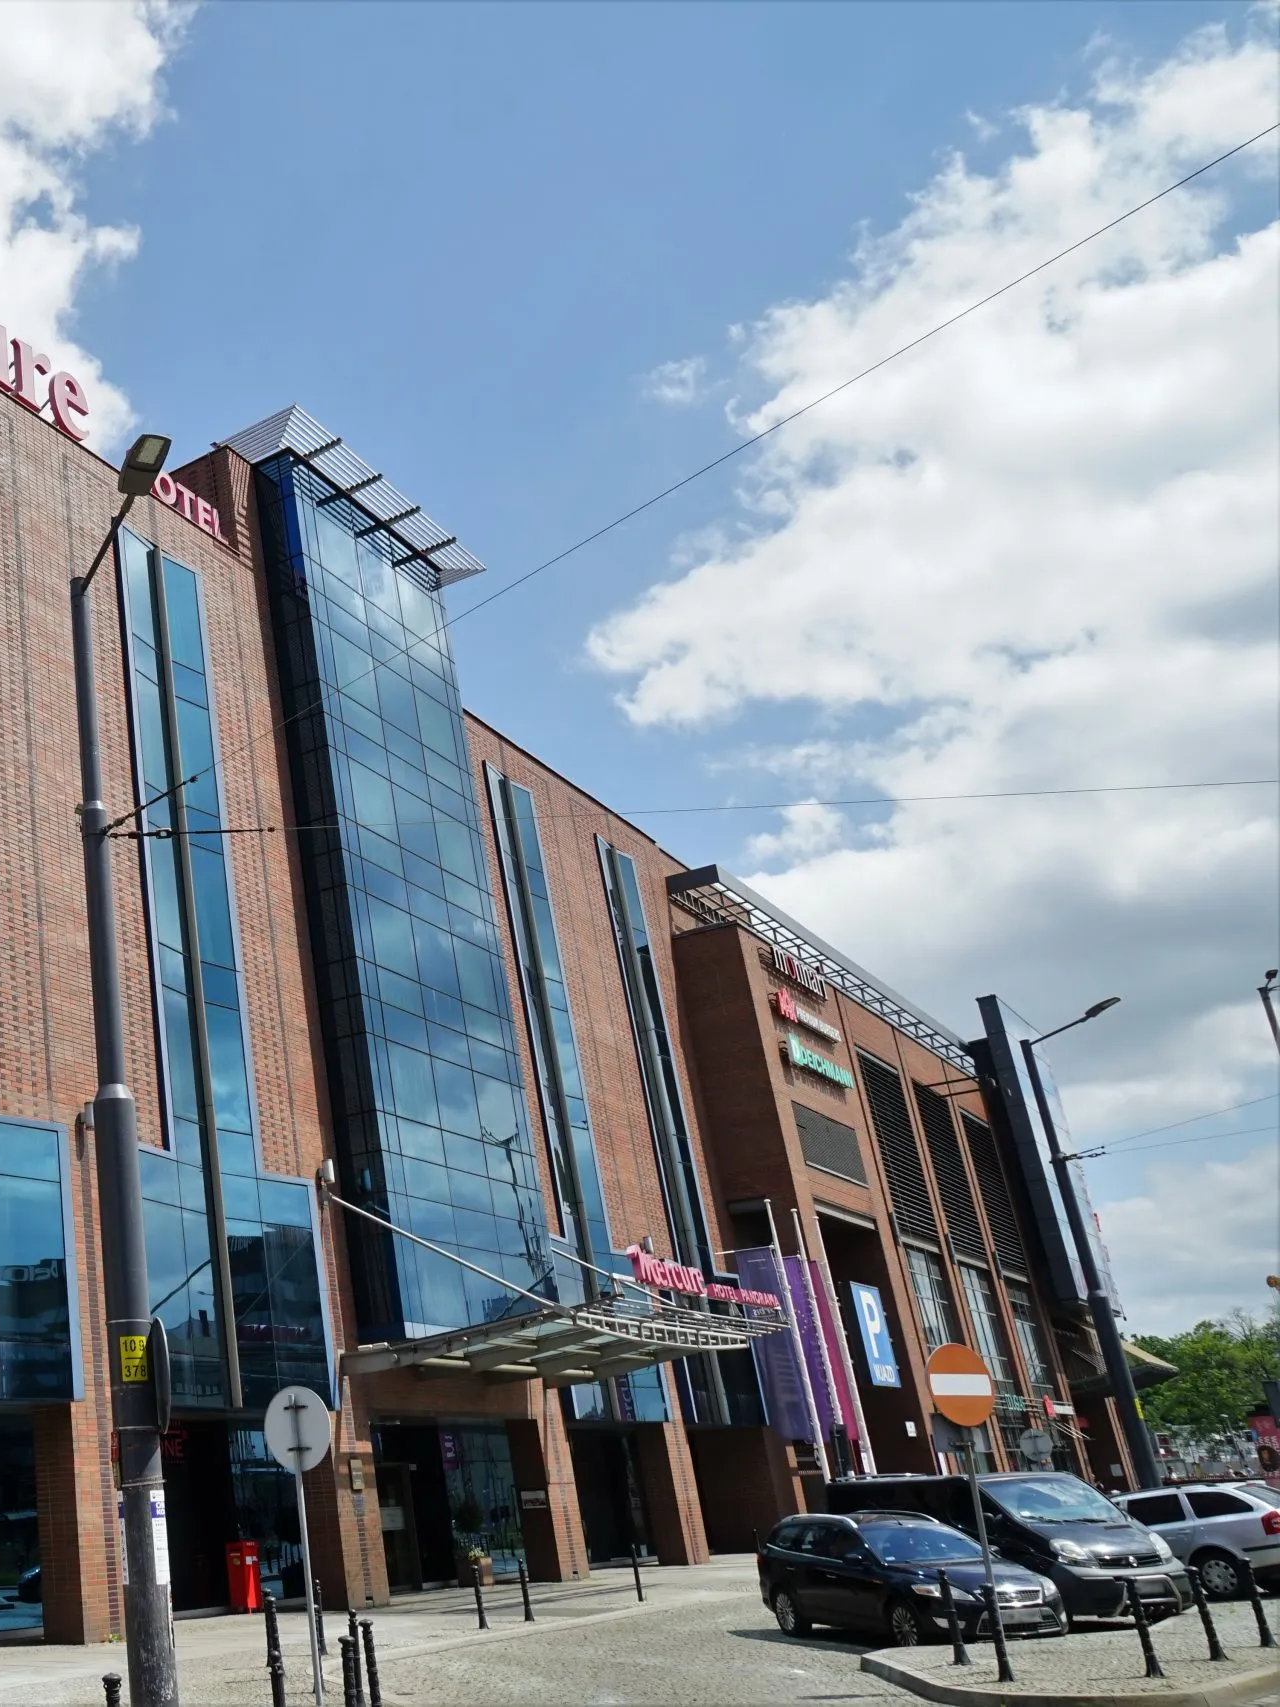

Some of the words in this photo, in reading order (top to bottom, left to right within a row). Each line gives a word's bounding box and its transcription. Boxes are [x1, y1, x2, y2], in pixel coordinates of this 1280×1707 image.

[150, 471, 229, 545] OTEL
[800, 1043, 854, 1089] DEICHMANN
[626, 1244, 708, 1296] Mercure
[712, 1284, 738, 1302] HOTEL
[740, 1289, 782, 1309] PANORAMA
[124, 1364, 147, 1378] 378
